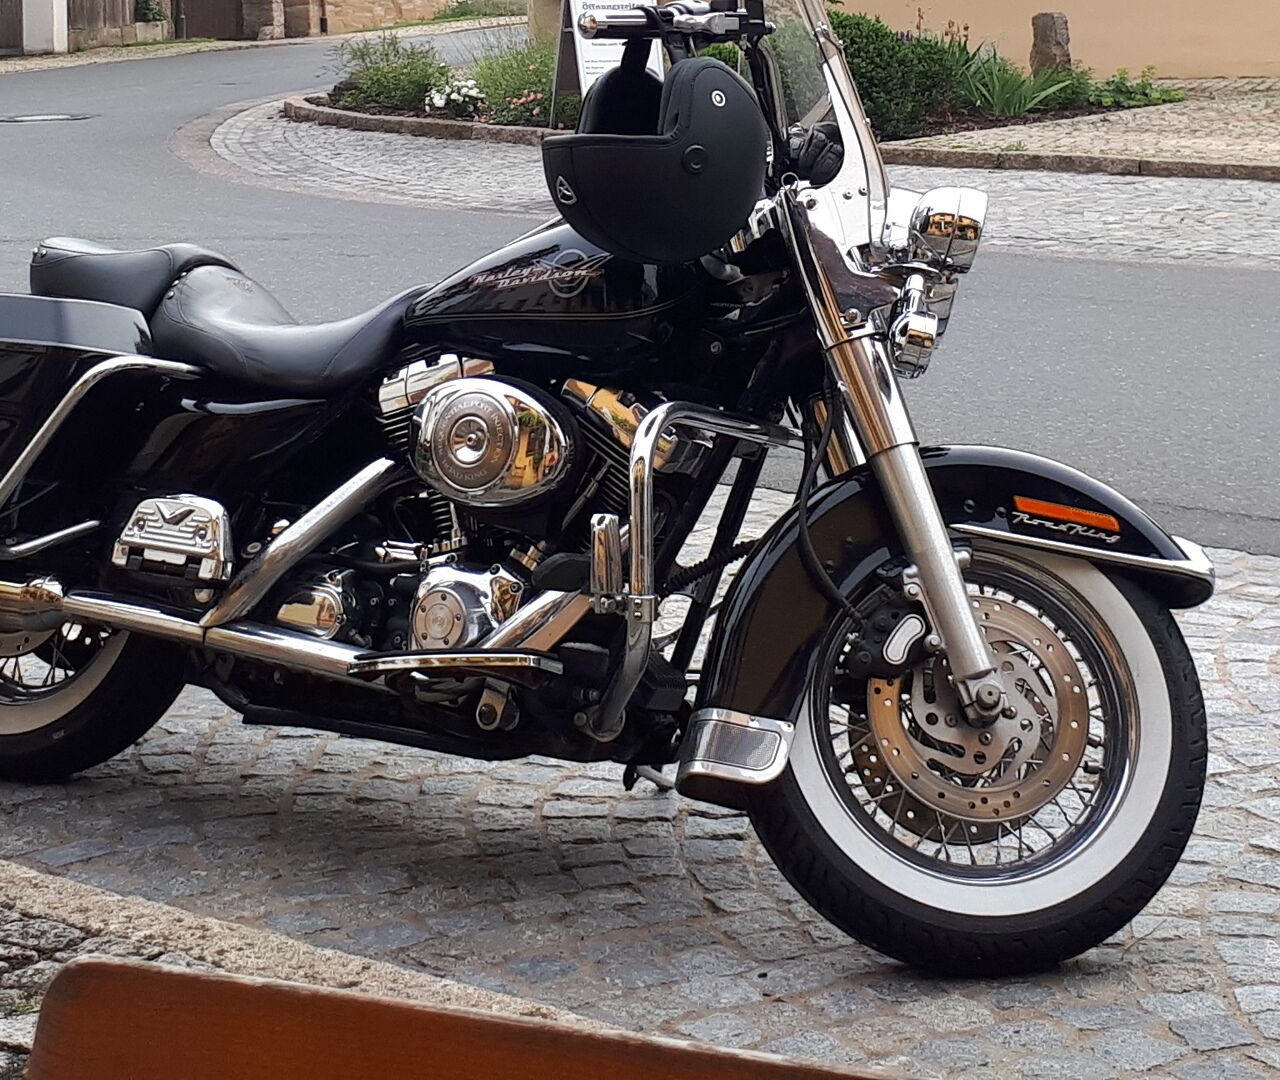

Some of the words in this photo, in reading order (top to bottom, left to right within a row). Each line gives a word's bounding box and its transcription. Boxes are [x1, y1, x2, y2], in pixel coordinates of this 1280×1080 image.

[497, 270, 589, 288] Davidson
[1012, 512, 1070, 532] Road
[1069, 523, 1121, 544] King
